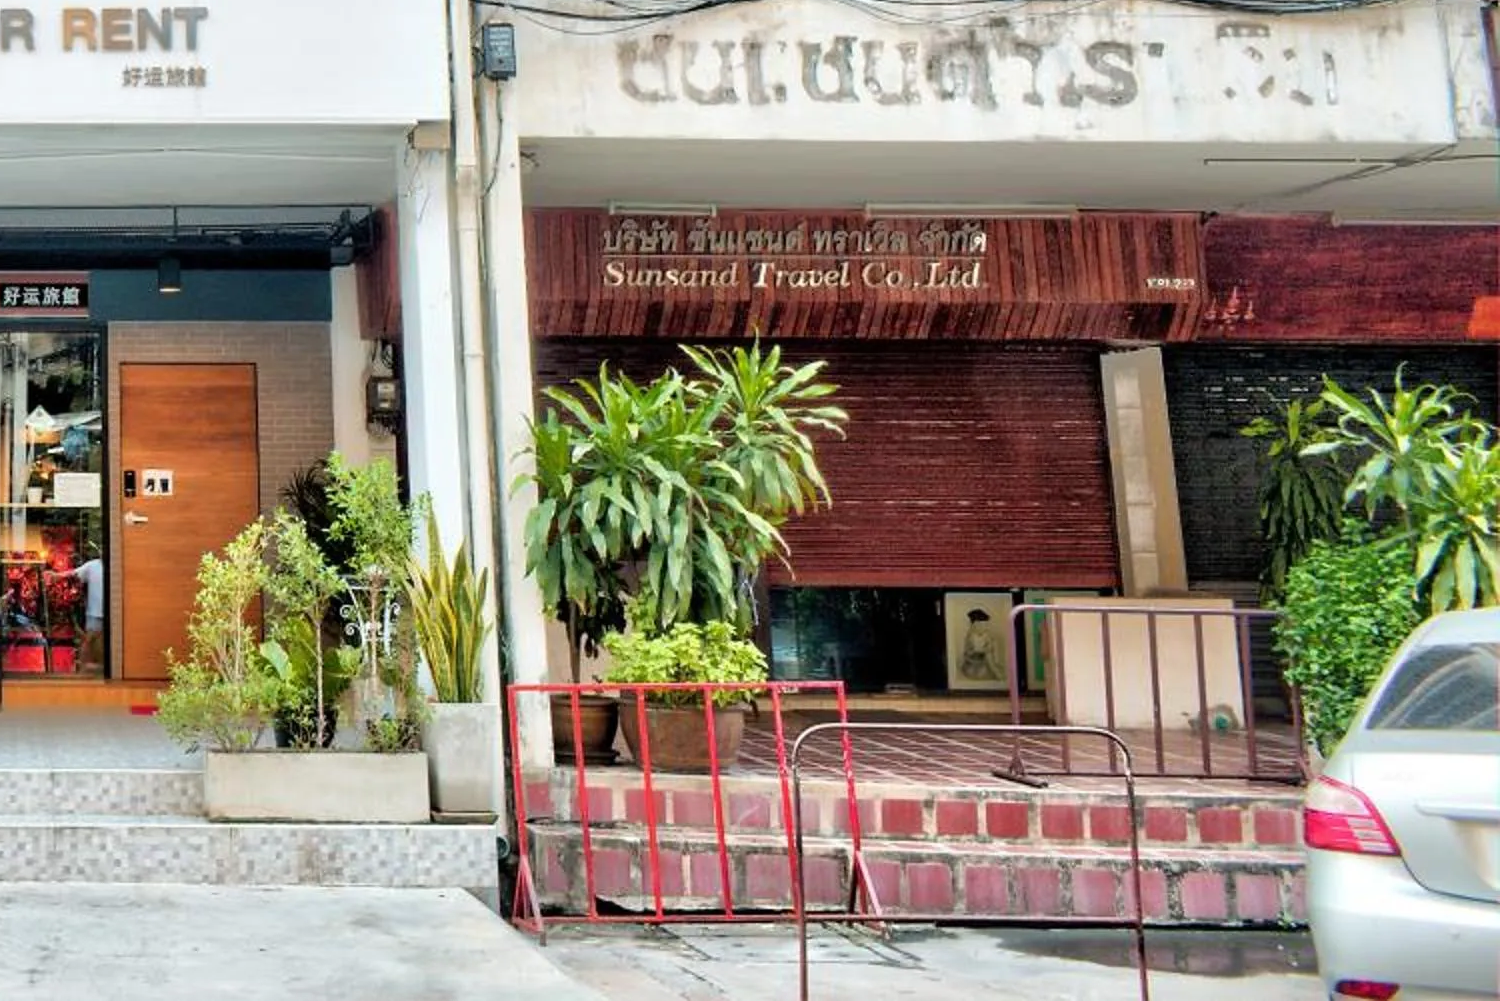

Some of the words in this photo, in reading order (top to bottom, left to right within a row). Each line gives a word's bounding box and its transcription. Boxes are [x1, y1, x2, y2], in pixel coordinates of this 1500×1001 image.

[62, 7, 208, 51] RENT
[602, 219, 678, 253] บริษัท
[918, 220, 987, 253] จำกัด
[603, 261, 738, 288] Sunsand
[753, 261, 852, 288] Travel
